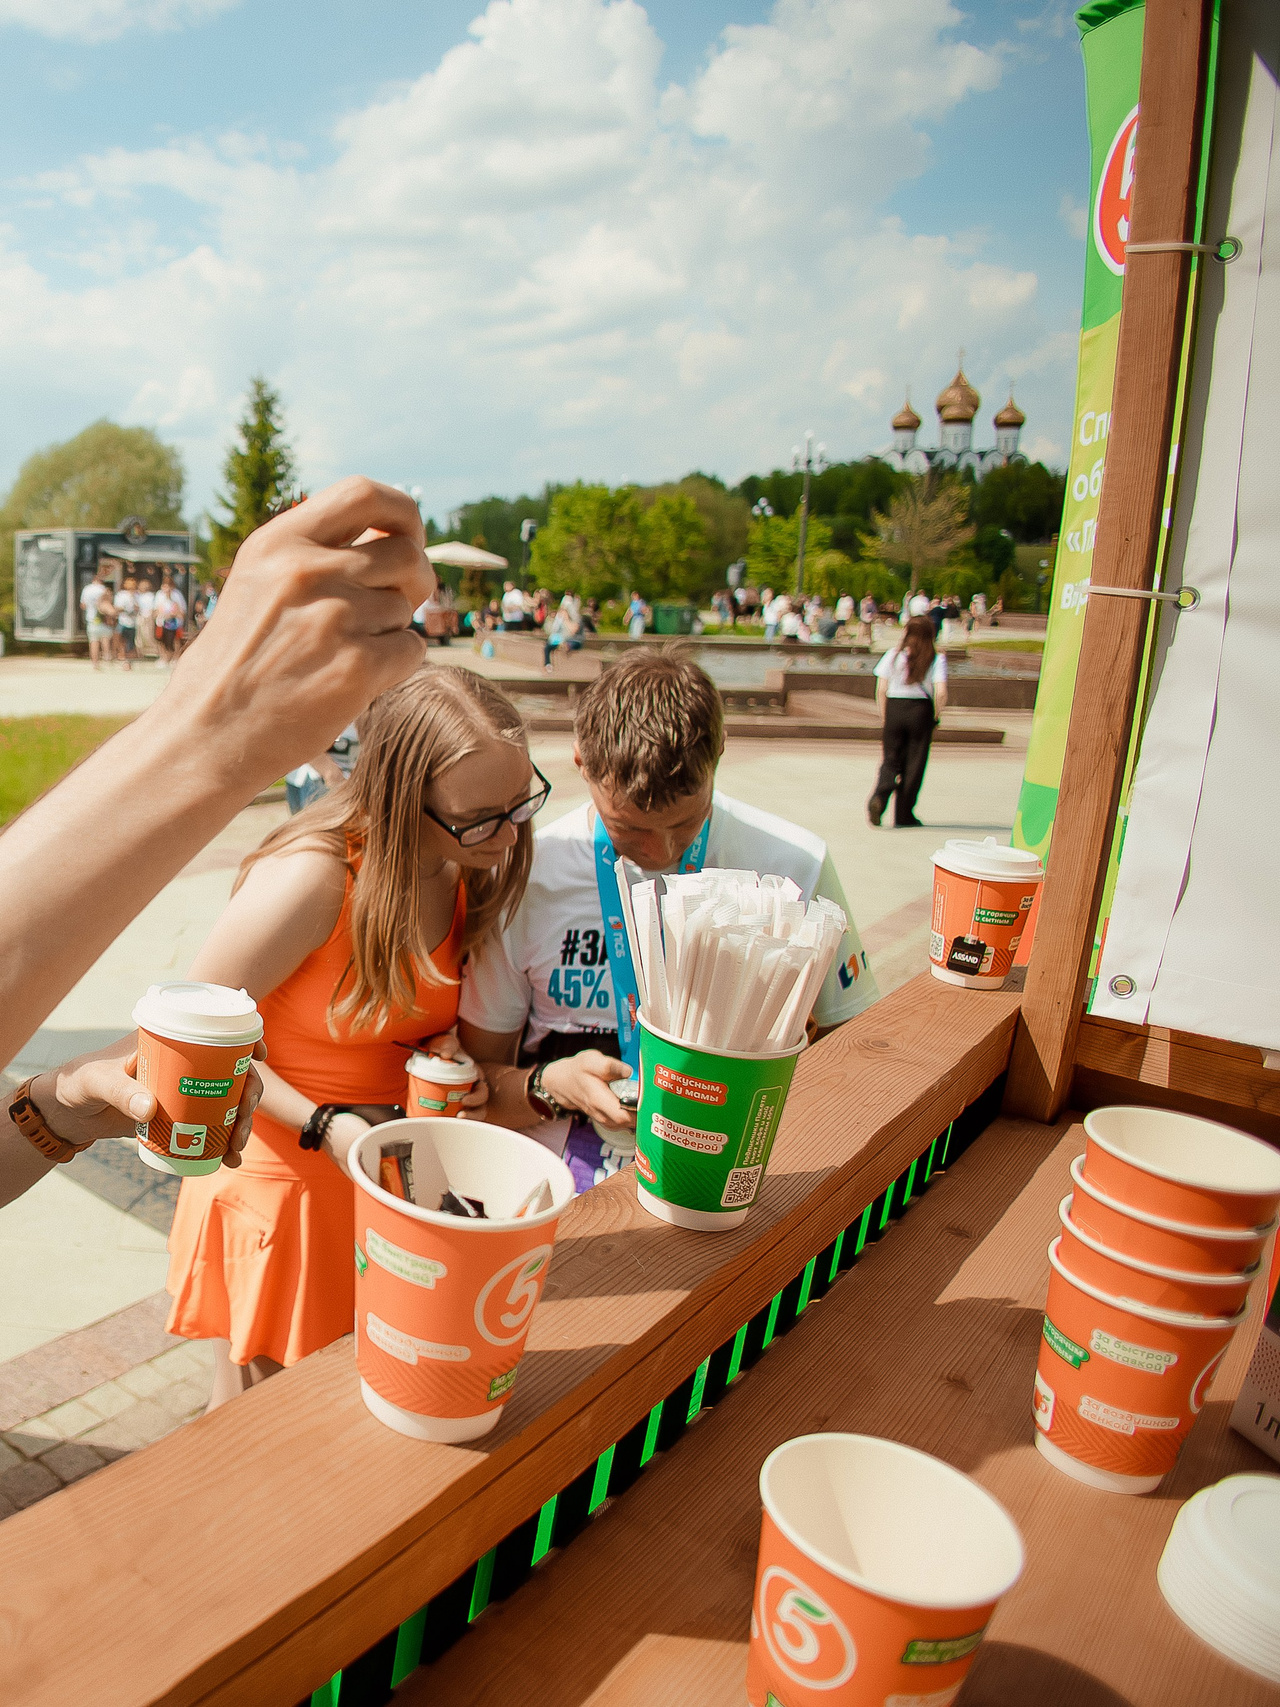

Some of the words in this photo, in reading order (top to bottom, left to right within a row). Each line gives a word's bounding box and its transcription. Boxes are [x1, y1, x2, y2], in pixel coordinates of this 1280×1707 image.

[1080, 411, 1111, 446] Сп
[1072, 458, 1105, 502] об
[987, 911, 1017, 919] горячим
[548, 968, 610, 1009] 45%
[182, 1078, 193, 1086] За
[195, 1080, 230, 1088] горячим
[657, 1078, 674, 1091] как
[676, 1084, 682, 1095] у
[685, 1089, 719, 1102] мамы
[658, 1066, 669, 1077] За
[671, 1074, 722, 1093] вкусным,
[653, 1127, 718, 1151] атмосферой
[654, 1115, 665, 1126] За
[667, 1117, 723, 1142] душевной
[1093, 1341, 1162, 1371] доставкой
[1095, 1331, 1110, 1344] За
[1114, 1340, 1172, 1363] быстрой
[1082, 1408, 1130, 1431] пенкой
[1084, 1399, 1100, 1411] За
[1103, 1407, 1175, 1428] воздушной
[773, 1588, 833, 1664] 5
